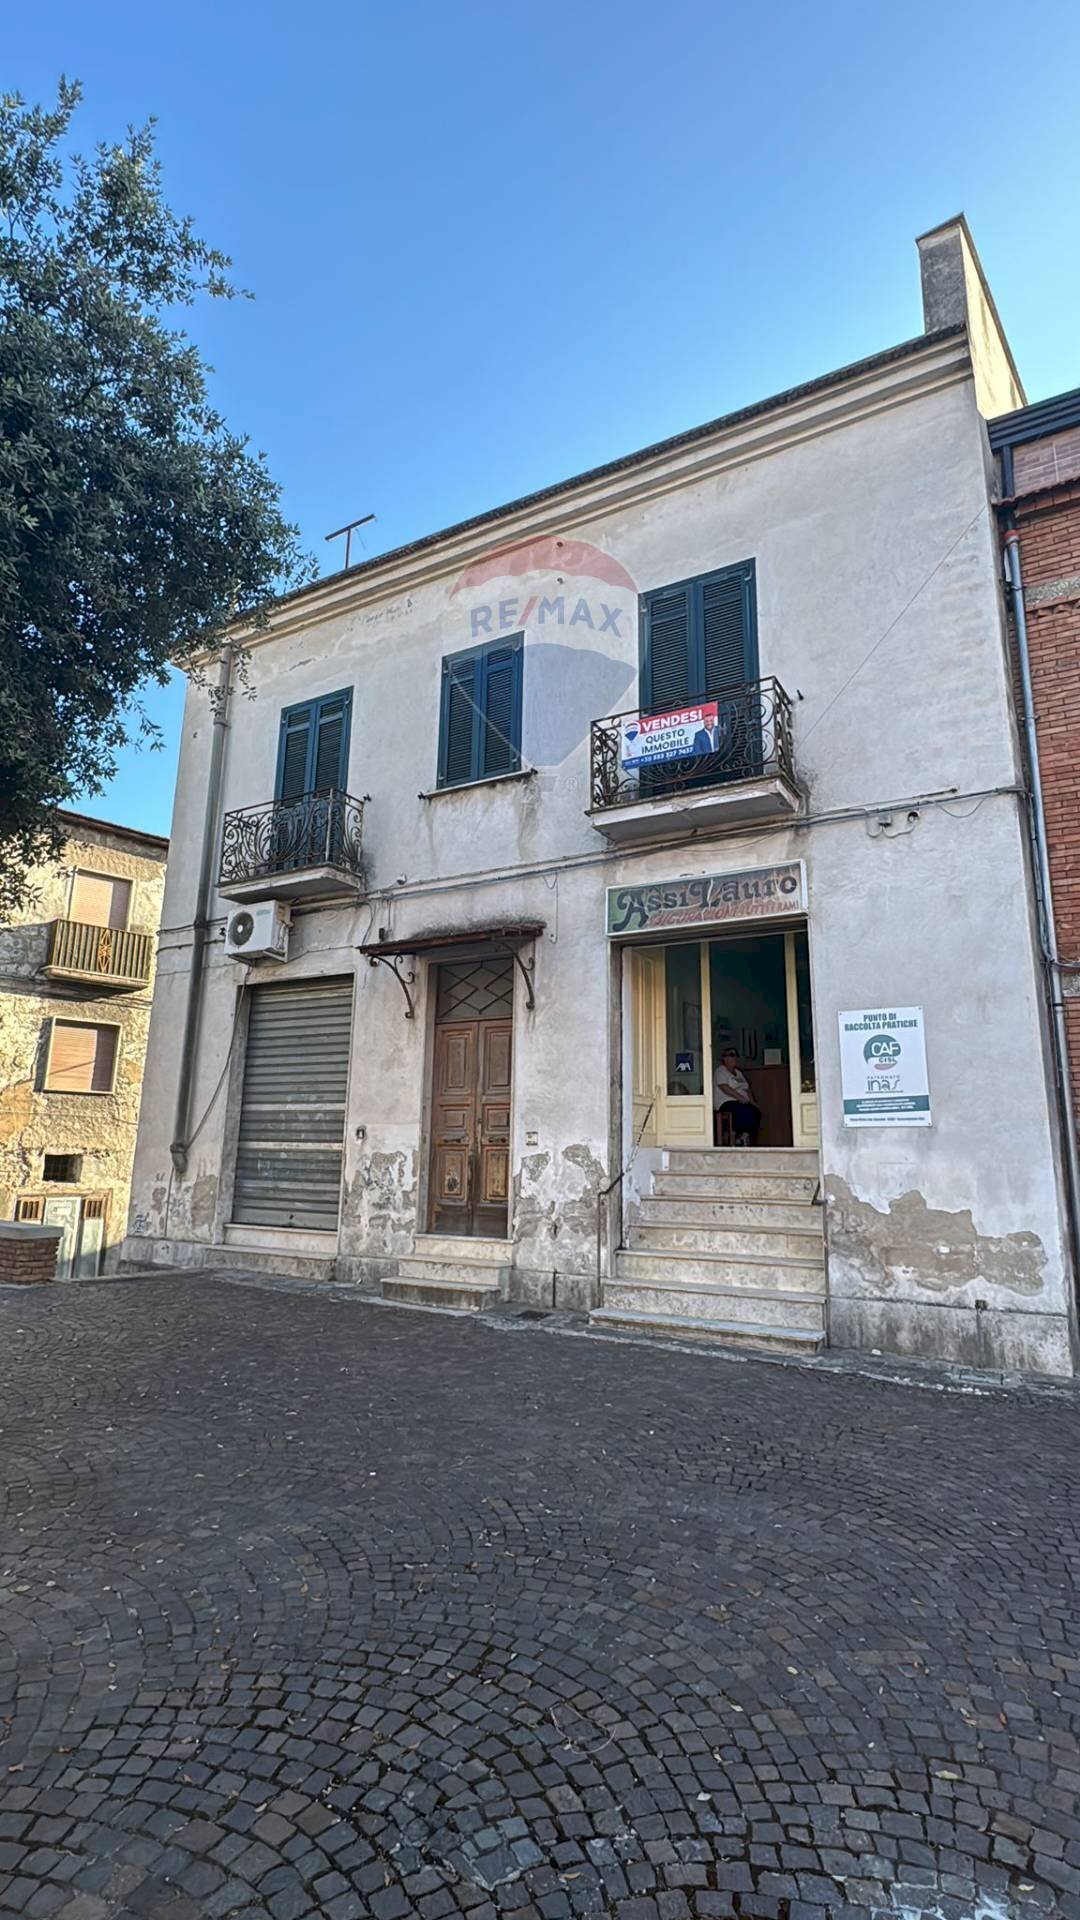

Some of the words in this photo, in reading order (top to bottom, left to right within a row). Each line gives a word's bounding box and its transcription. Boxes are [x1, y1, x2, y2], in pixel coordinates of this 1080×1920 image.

[642, 710, 702, 731] VENDESI
[645, 728, 686, 744] QUESTO
[641, 737, 690, 755] IMMOBILE
[613, 887, 689, 932] Assi
[689, 876, 797, 908] Lauro
[844, 1021, 881, 1031] RACCOLTA
[882, 1019, 918, 1029] PRATICHE
[863, 1013, 887, 1022] PUNTO
[889, 1012, 897, 1021] DI
[871, 1041, 900, 1056] CAF
